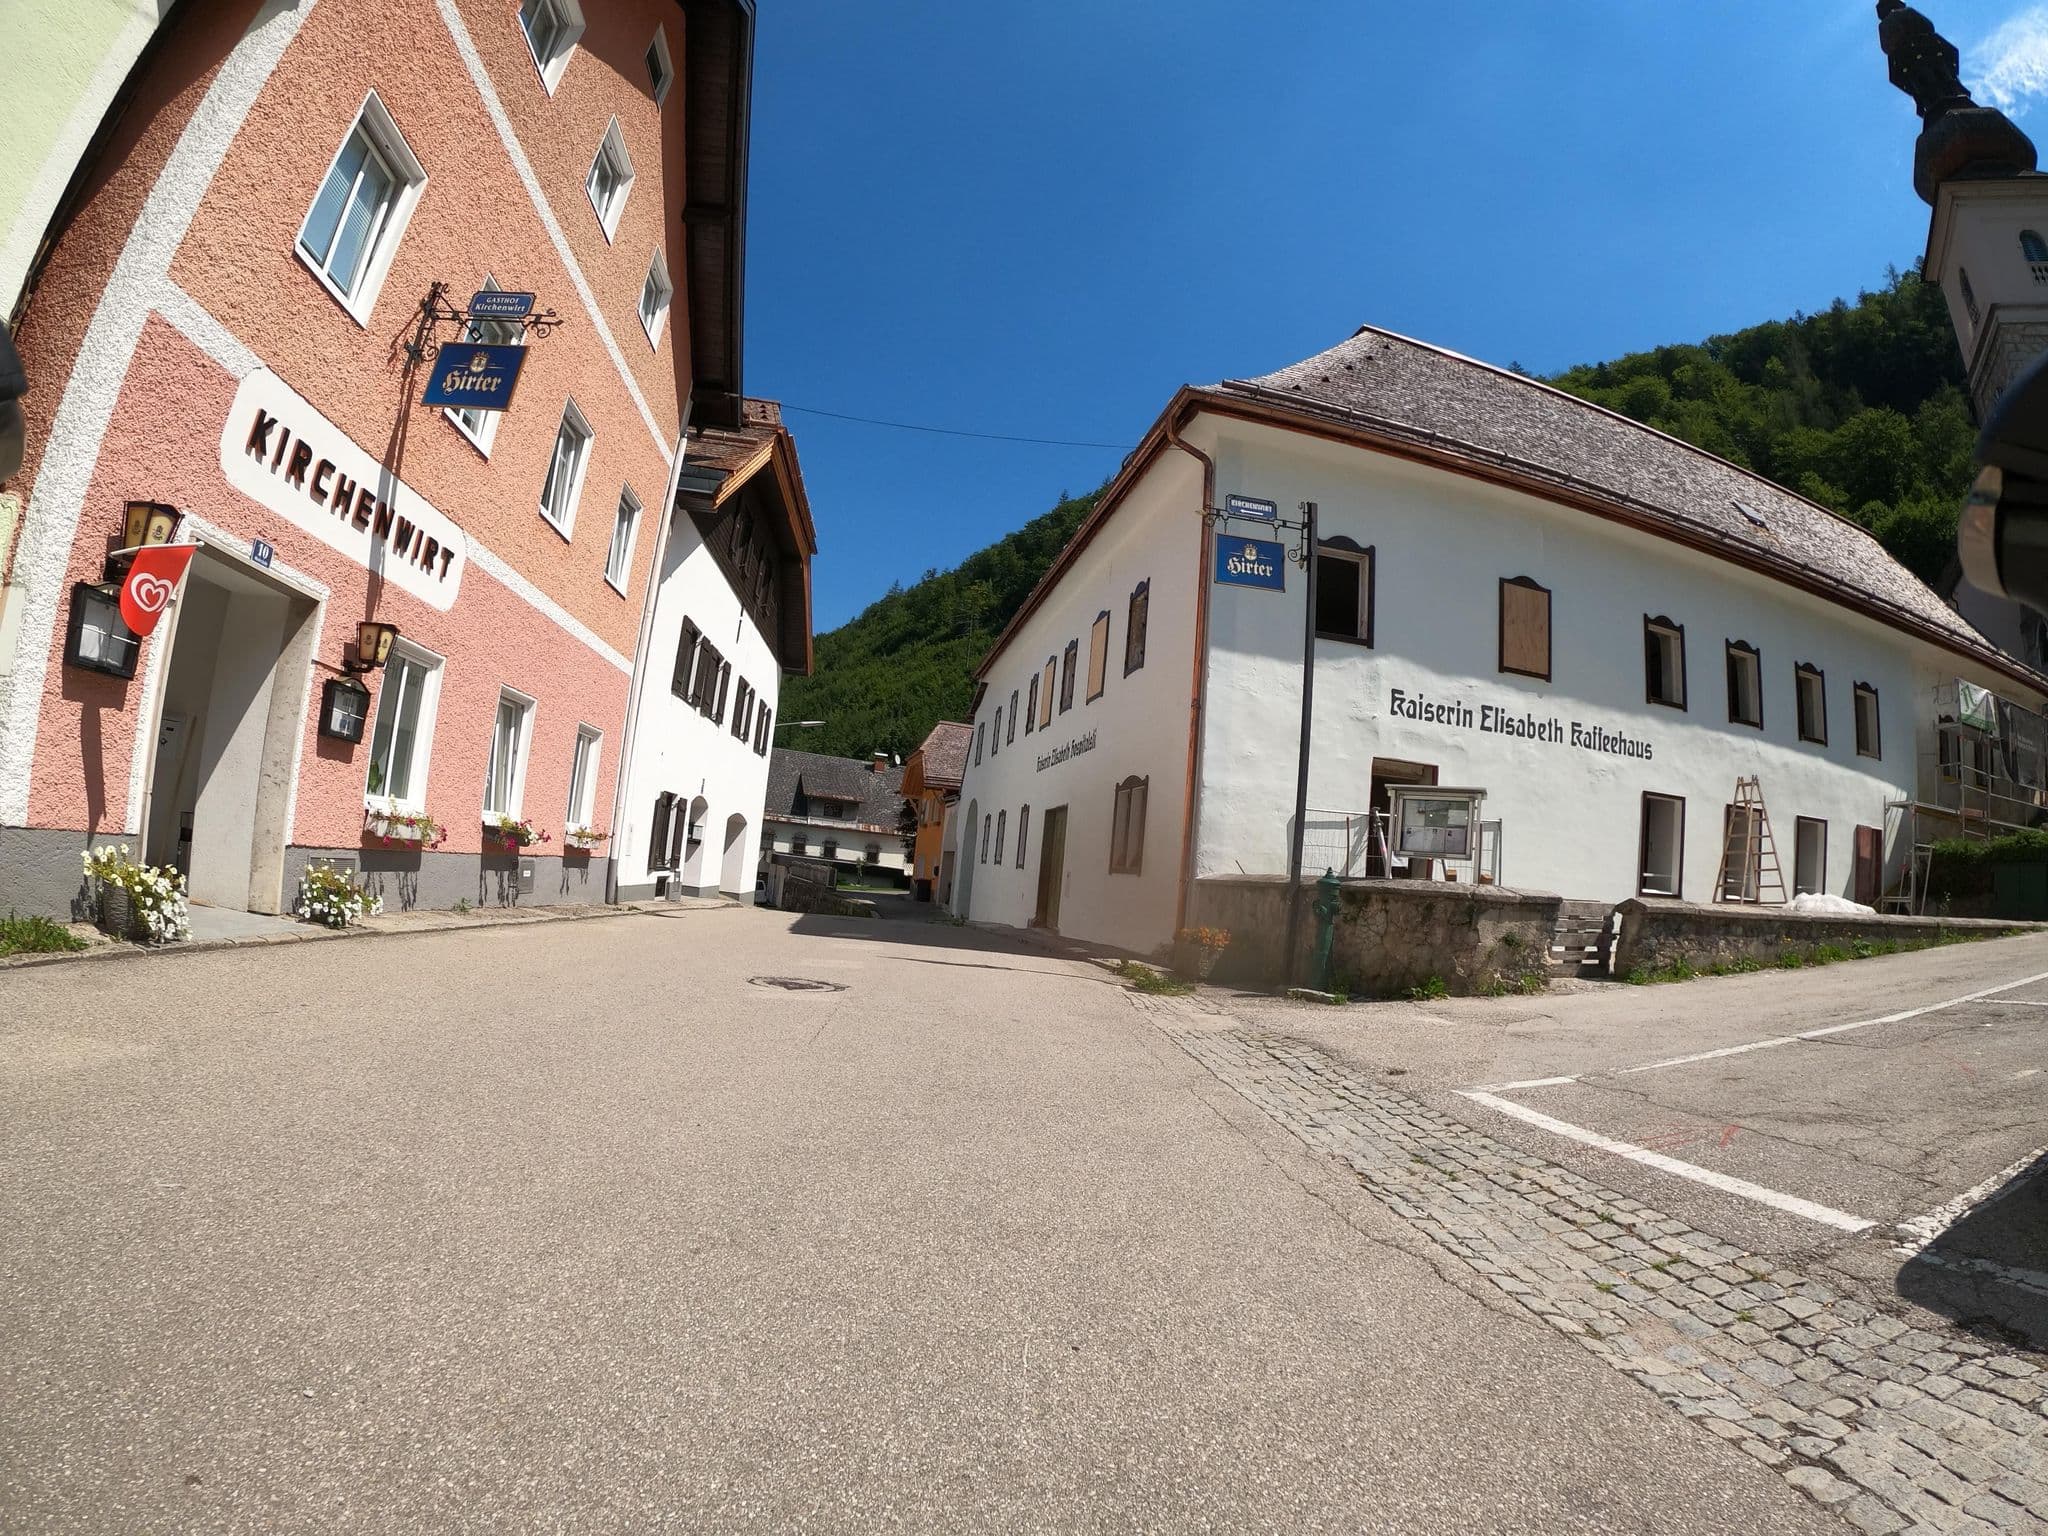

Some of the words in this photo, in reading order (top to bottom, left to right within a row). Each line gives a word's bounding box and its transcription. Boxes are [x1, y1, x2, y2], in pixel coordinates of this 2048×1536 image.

[475, 303, 526, 312] Kirchenwirt
[486, 296, 520, 304] GASTHOF
[442, 370, 502, 396] Hirter
[246, 408, 455, 582] KIRCHENWIRT
[1230, 499, 1273, 512] KIRCHENWIRT
[258, 543, 270, 559] 10
[1227, 556, 1273, 577] Hirter
[1390, 688, 1474, 729] Kaiserin
[1479, 704, 1564, 744] Elisabeth
[1570, 721, 1654, 761] Kaffeehaus
